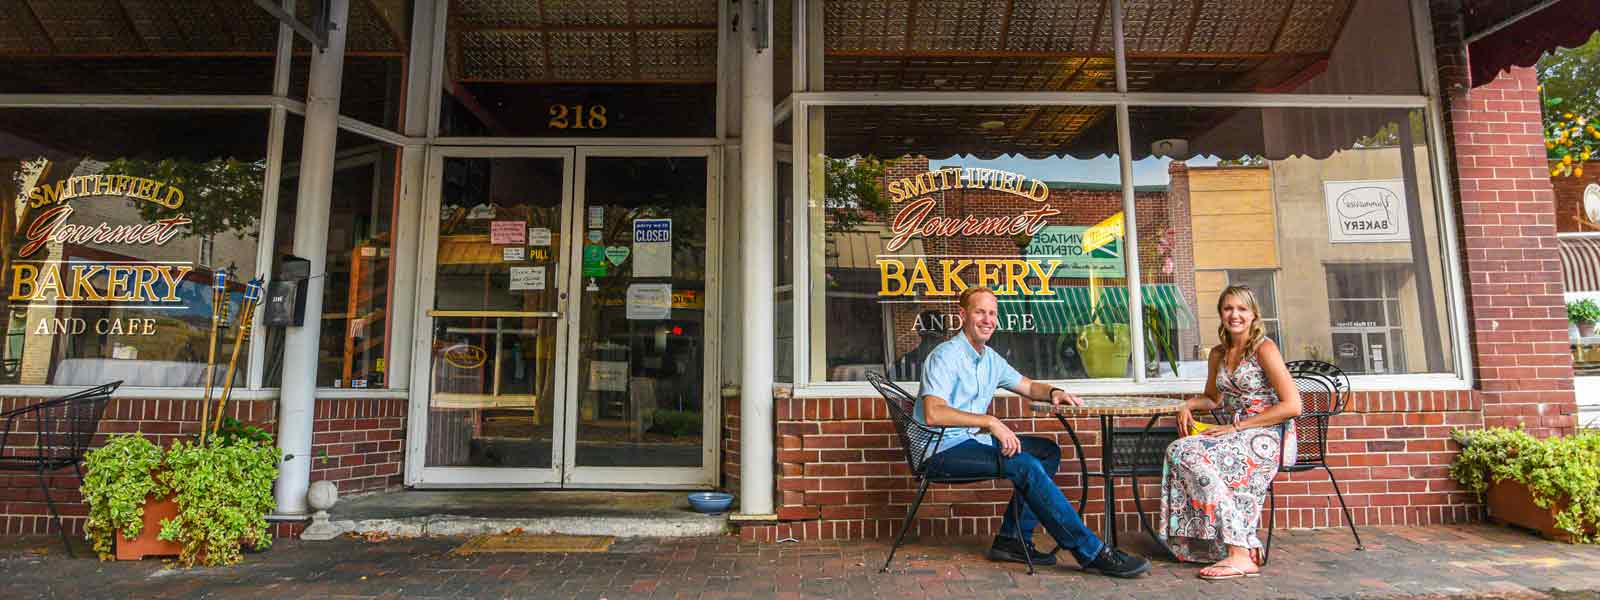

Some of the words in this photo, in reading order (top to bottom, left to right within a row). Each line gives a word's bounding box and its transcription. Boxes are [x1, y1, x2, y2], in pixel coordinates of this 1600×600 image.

[549, 104, 608, 129] 218
[29, 175, 185, 209] SMITHFIELD
[888, 168, 1049, 202] SMITHFIELD
[19, 205, 192, 257] Gourmet
[636, 229, 669, 242] CLOSED
[887, 198, 1061, 251] Gourmet
[530, 248, 548, 260] PULL
[8, 265, 192, 302] BAKERY
[876, 259, 1064, 296] BAKERY
[35, 319, 86, 335] AND
[96, 319, 157, 335] CAFE
[911, 314, 963, 331] AND
[996, 313, 1036, 331] FE
